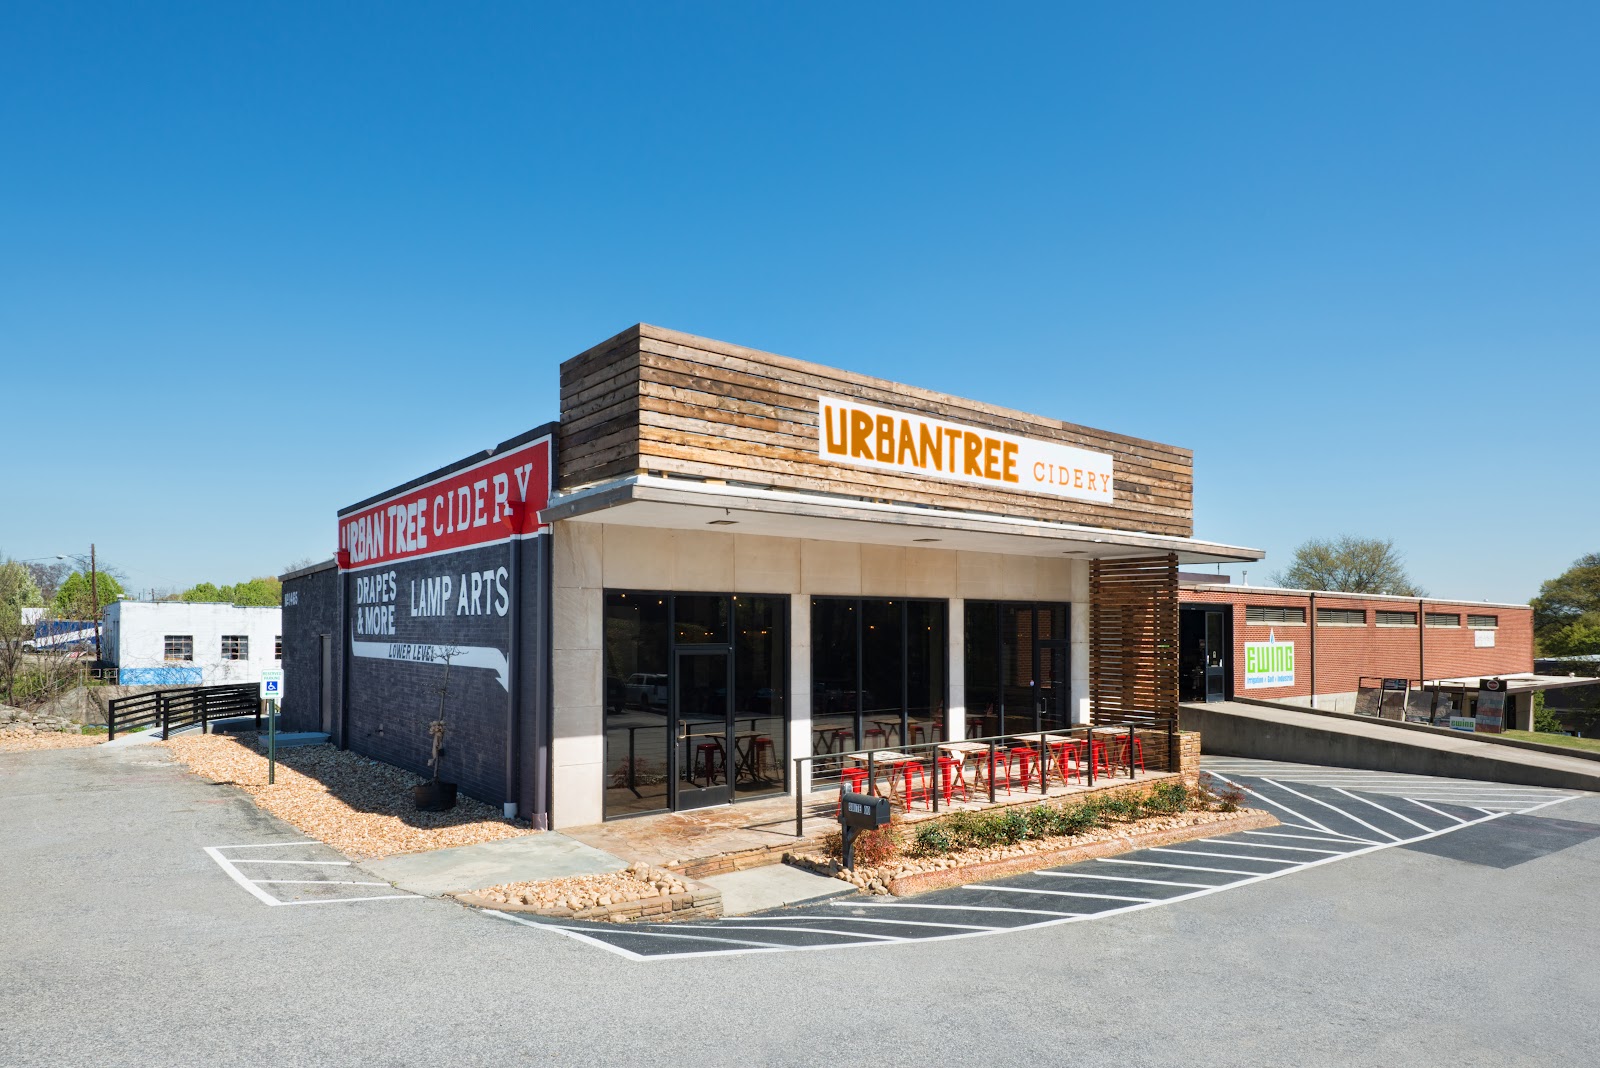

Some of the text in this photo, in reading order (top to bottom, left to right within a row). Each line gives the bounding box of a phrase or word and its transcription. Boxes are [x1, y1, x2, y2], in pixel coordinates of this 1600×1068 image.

[1033, 461, 1110, 493] CIDERY
[342, 510, 385, 564] URBAN
[387, 498, 427, 554] TREE
[357, 570, 397, 605] DRAPES
[410, 566, 509, 617] LAMP ARTS
[357, 604, 396, 635] & MORE
[388, 644, 435, 662] LOWER LEVEL
